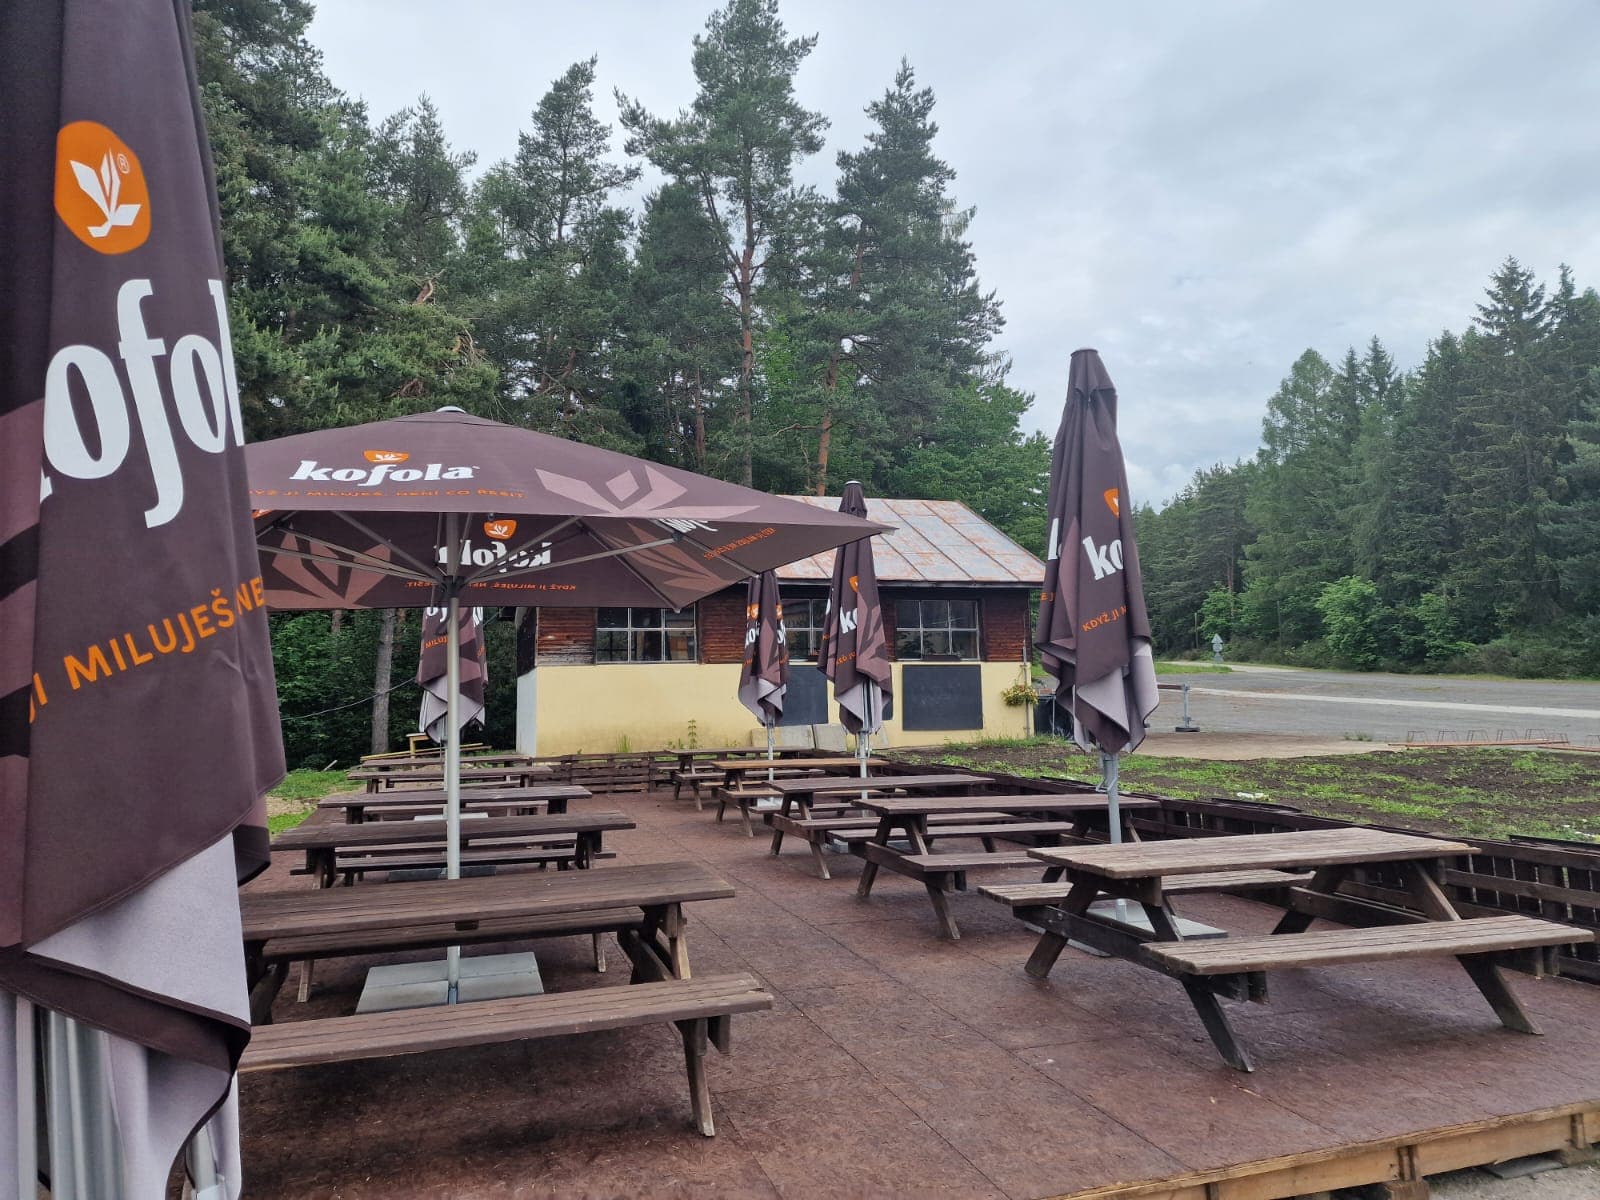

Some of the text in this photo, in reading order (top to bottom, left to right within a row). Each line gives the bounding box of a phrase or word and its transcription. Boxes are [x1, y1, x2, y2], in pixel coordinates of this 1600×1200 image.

[40, 278, 245, 528] ofol
[289, 460, 474, 486] kofola
[63, 588, 236, 691] MILUJEŠ
